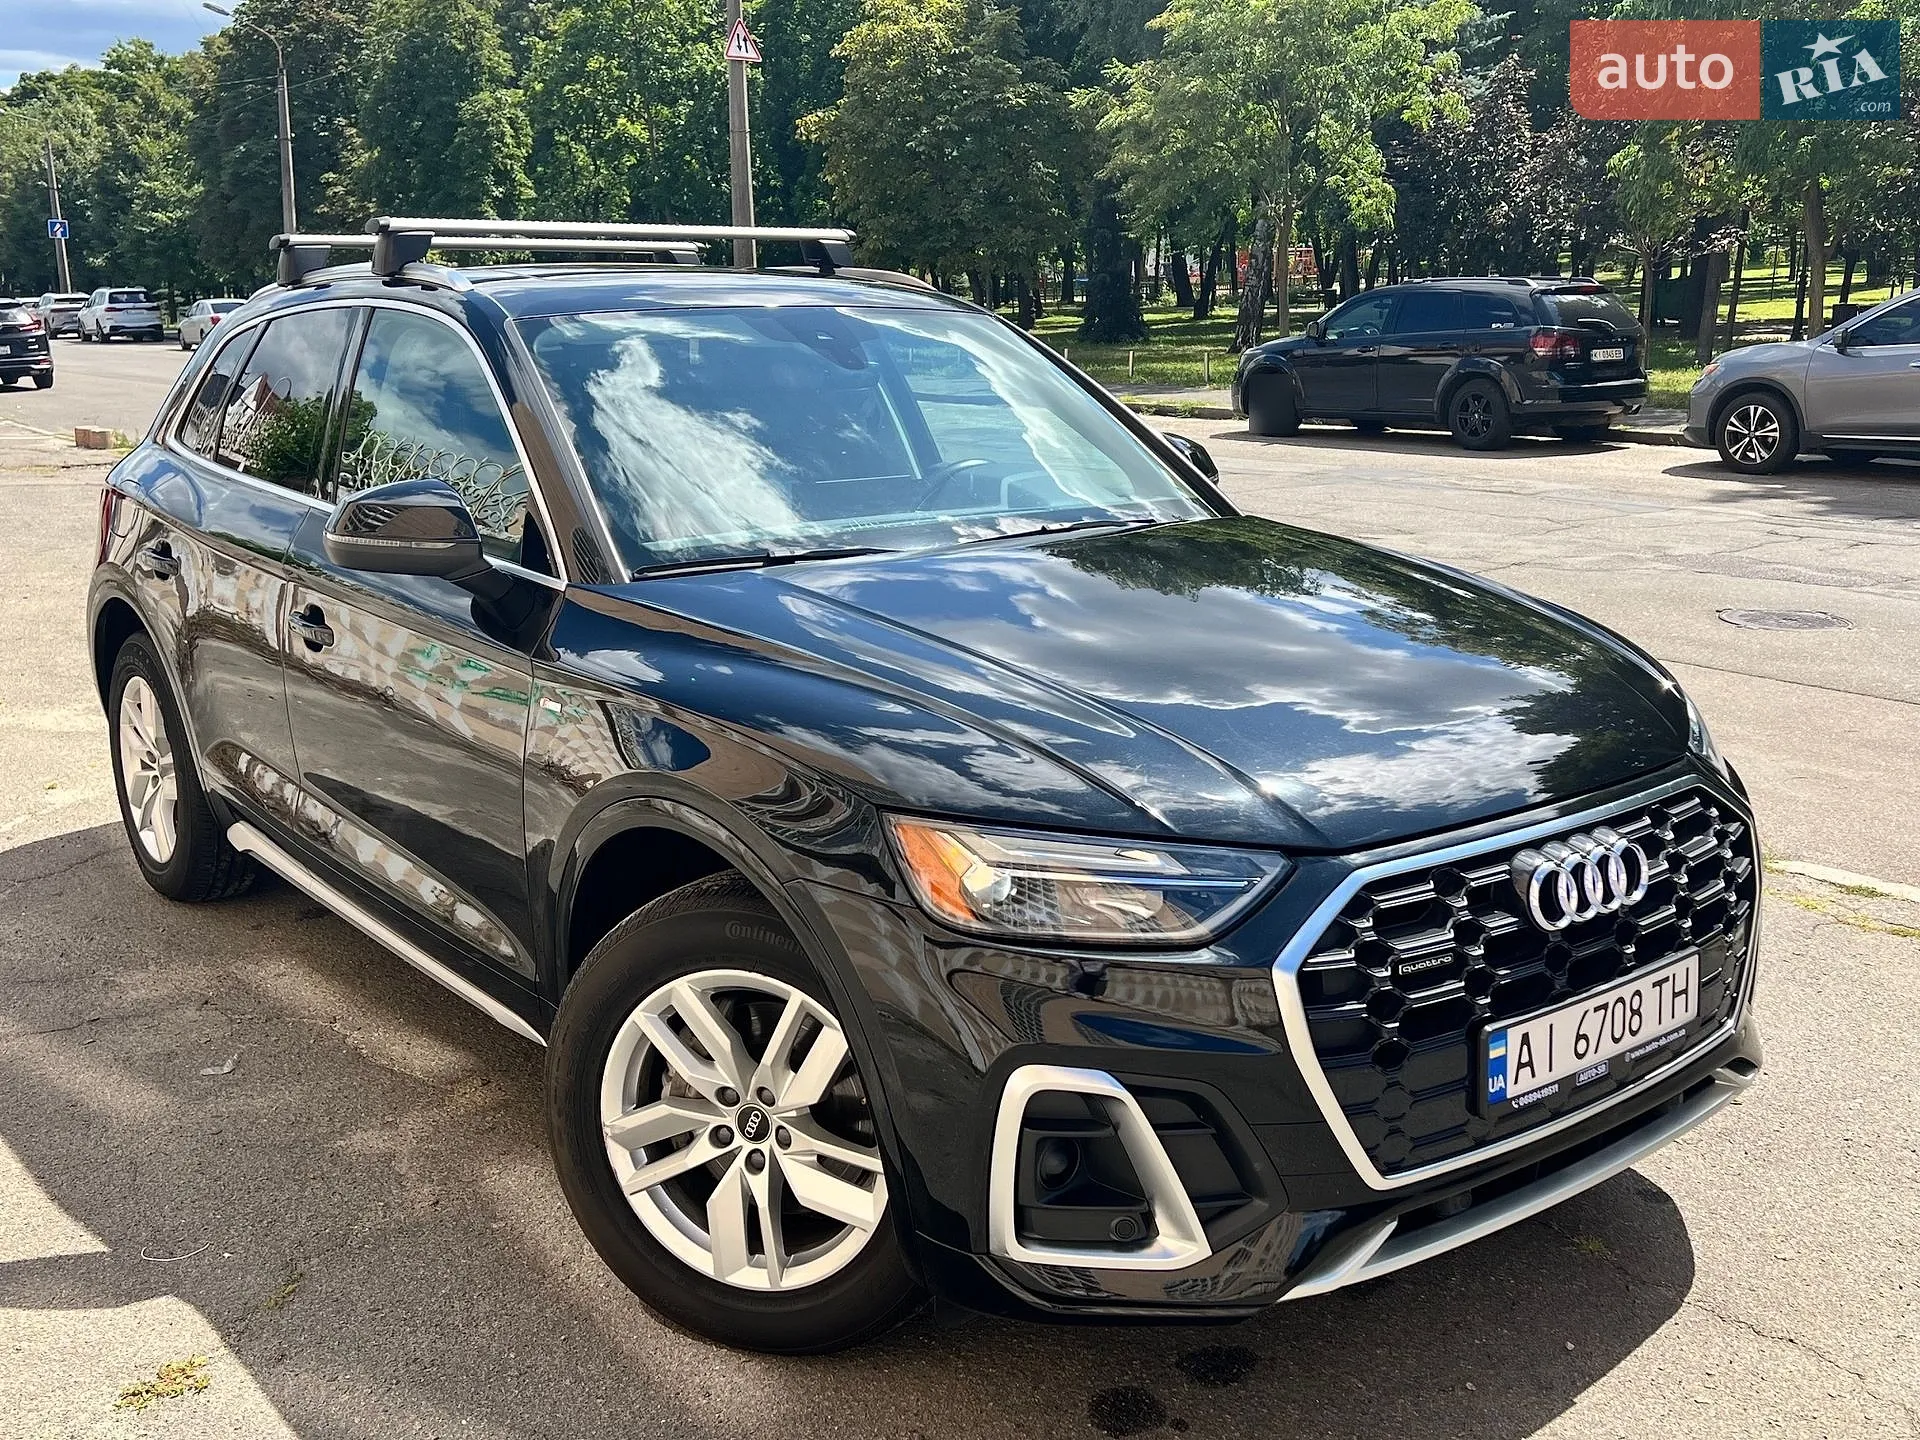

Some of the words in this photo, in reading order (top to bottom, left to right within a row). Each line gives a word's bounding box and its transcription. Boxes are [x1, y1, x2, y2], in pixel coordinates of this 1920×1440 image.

[1402, 956, 1452, 973] quattro
[1514, 1023, 1553, 1085] AI
[1574, 990, 1642, 1060] 6708
[1652, 967, 1689, 1025] TH
[1489, 1074, 1505, 1092] UA
